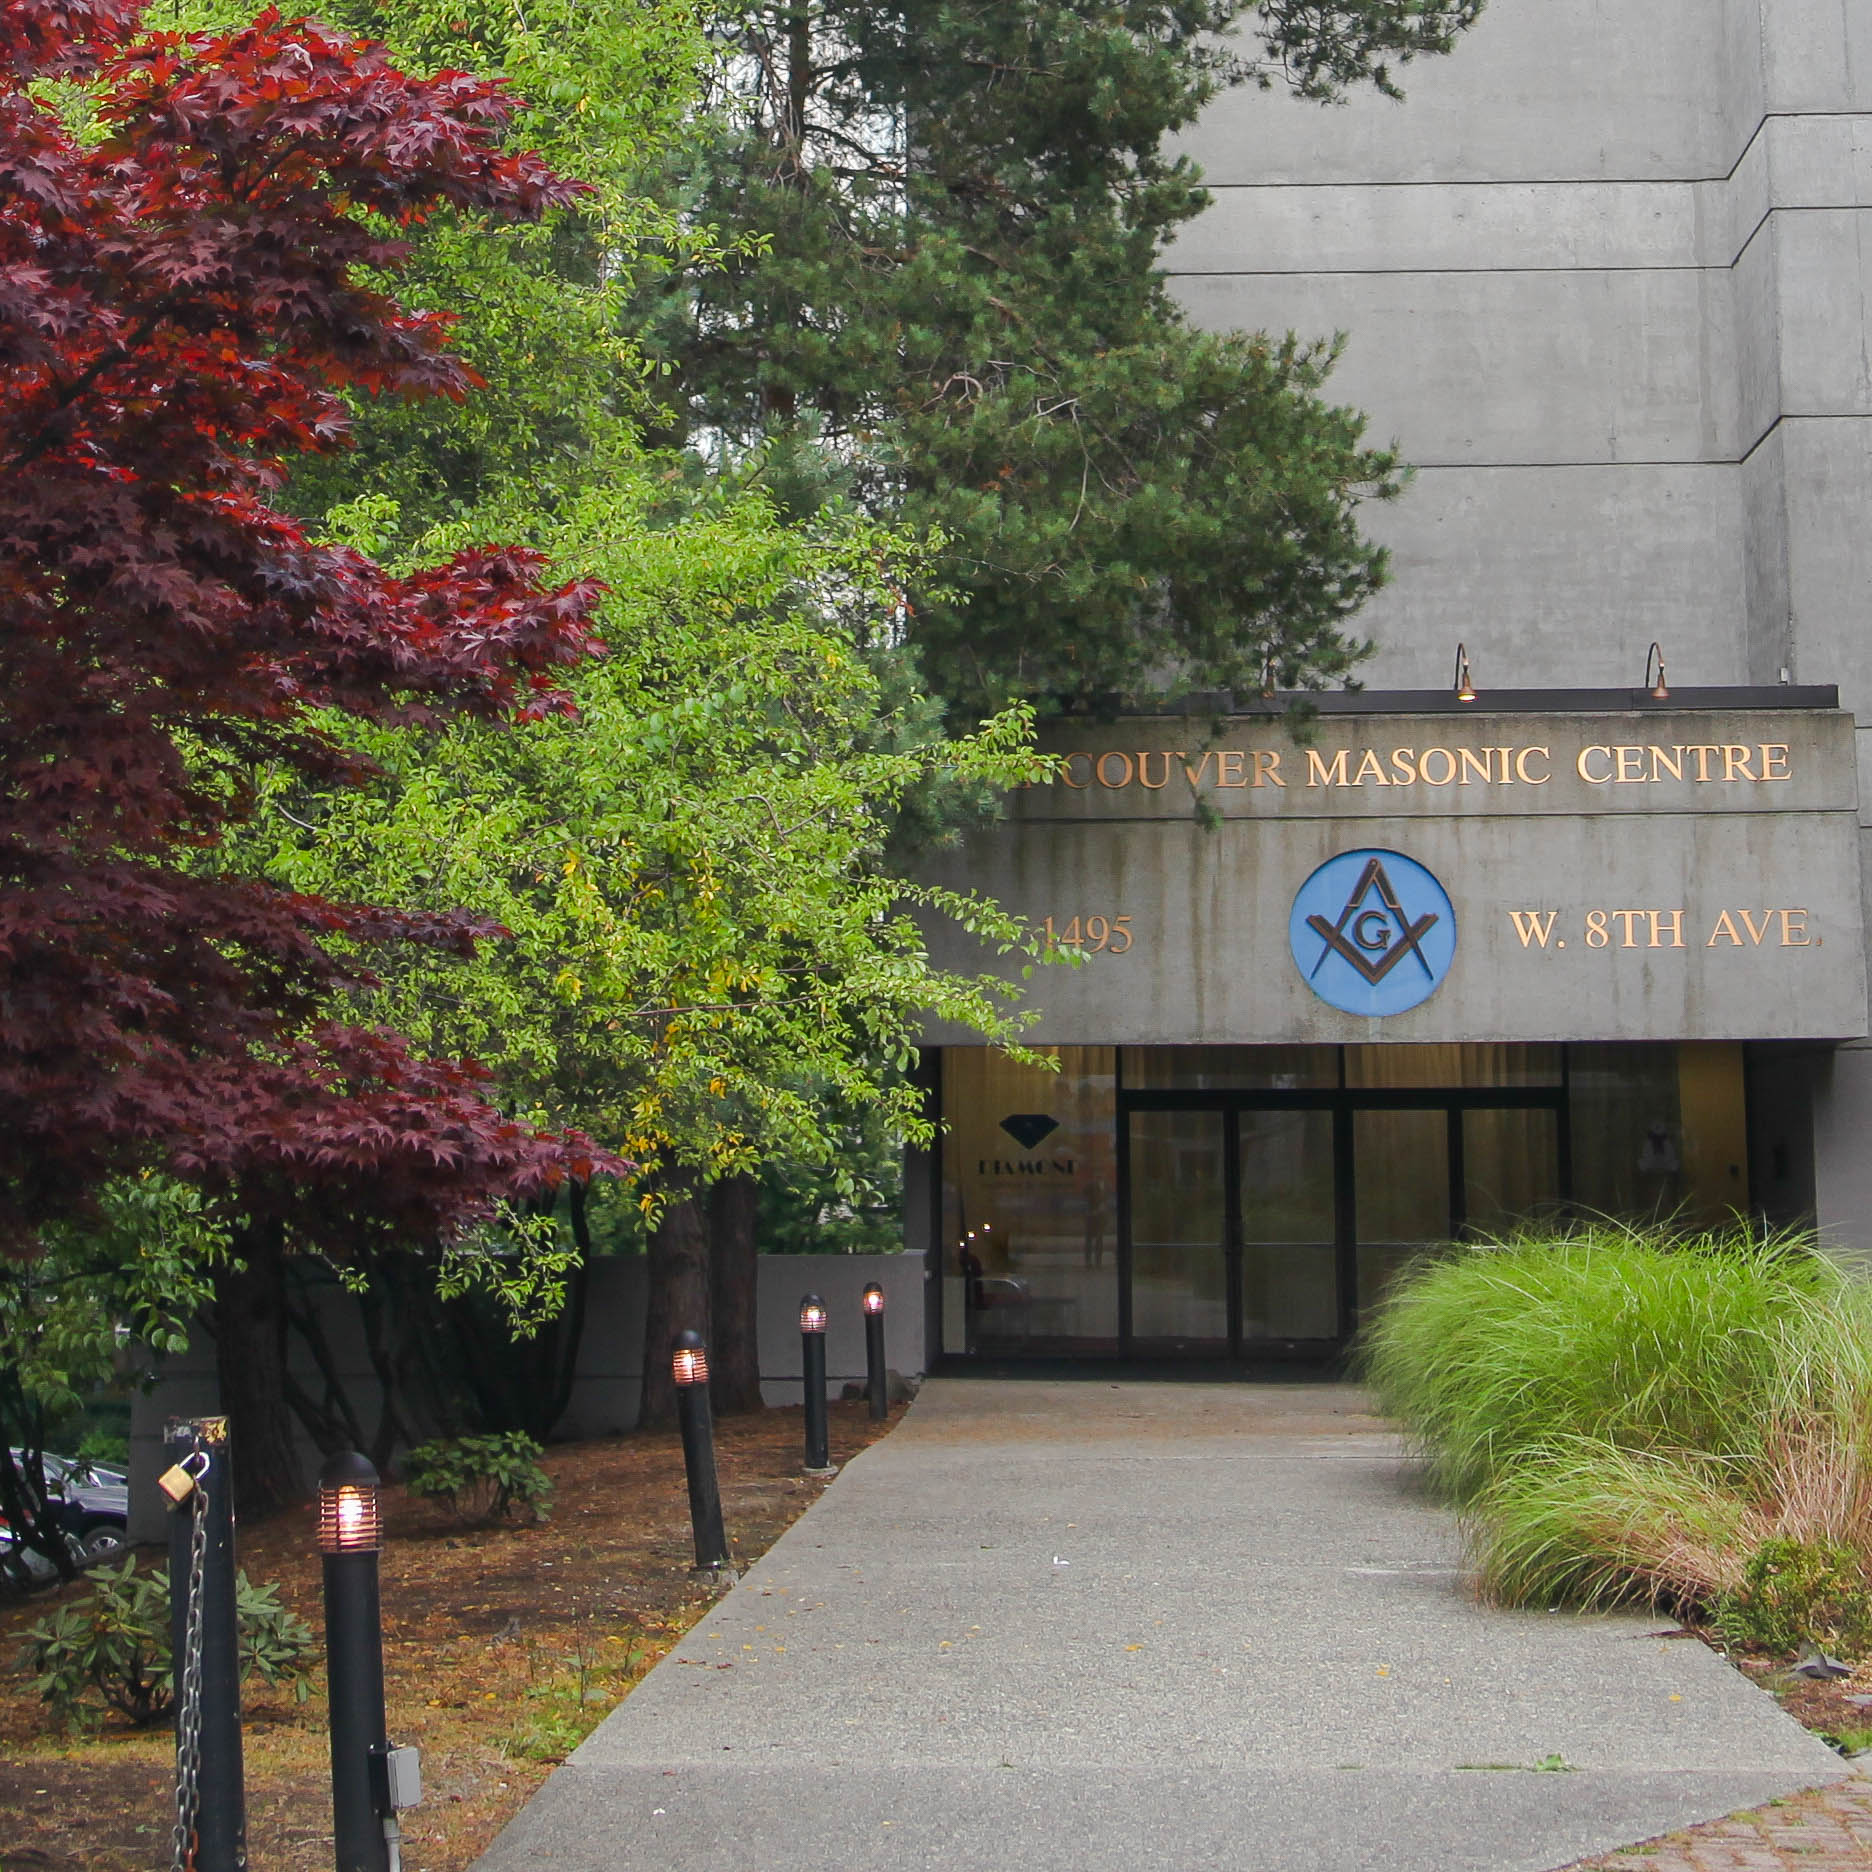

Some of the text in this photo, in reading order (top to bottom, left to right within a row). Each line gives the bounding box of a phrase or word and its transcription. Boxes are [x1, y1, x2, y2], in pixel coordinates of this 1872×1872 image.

[1014, 743, 1793, 789] COUVER MASONIC CENTRE
[1043, 914, 1134, 954] 1495
[1352, 910, 1392, 951] G
[1508, 908, 1825, 949] W. 8TH AVE.
